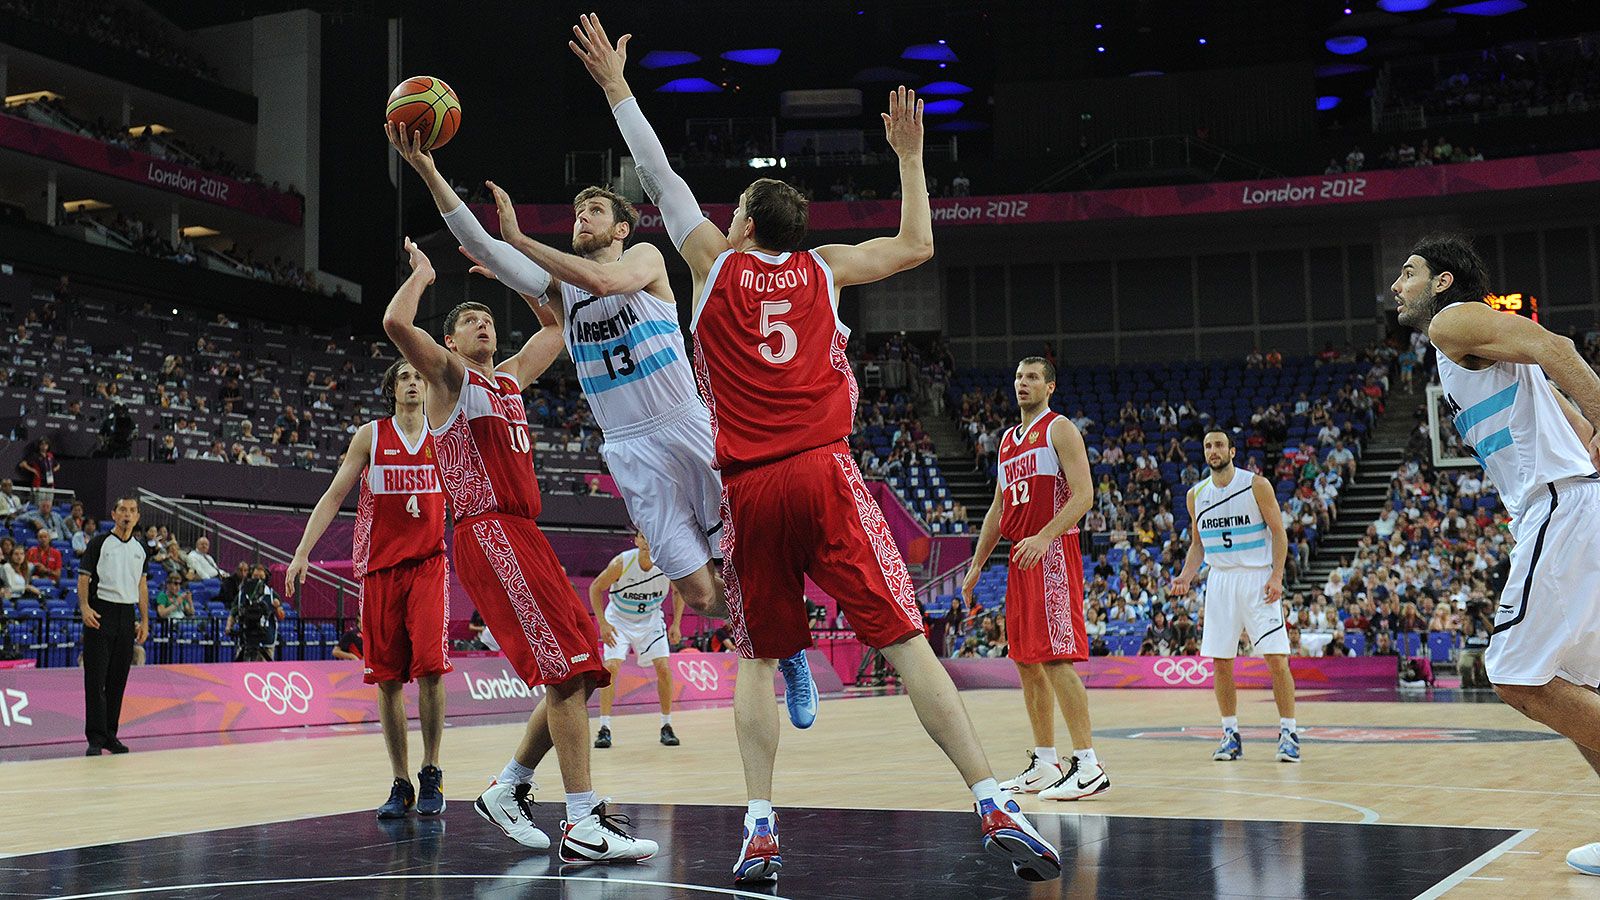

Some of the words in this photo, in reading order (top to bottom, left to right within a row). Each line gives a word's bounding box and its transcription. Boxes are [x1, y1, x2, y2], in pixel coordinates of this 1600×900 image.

[148, 162, 197, 192] London
[200, 177, 229, 200] 2012
[1242, 183, 1315, 204] London
[1320, 178, 1367, 198] 2012
[931, 202, 981, 220] ndon
[986, 200, 1028, 218] 2012
[740, 267, 808, 292] MOZGOV
[758, 299, 798, 364] 5
[602, 344, 636, 381] 13
[508, 425, 530, 454] 10
[405, 494, 421, 518] 4
[1010, 480, 1030, 507] 12
[1201, 514, 1251, 530] ARGENTINA
[1222, 531, 1233, 549] 5
[637, 603, 647, 614] 8
